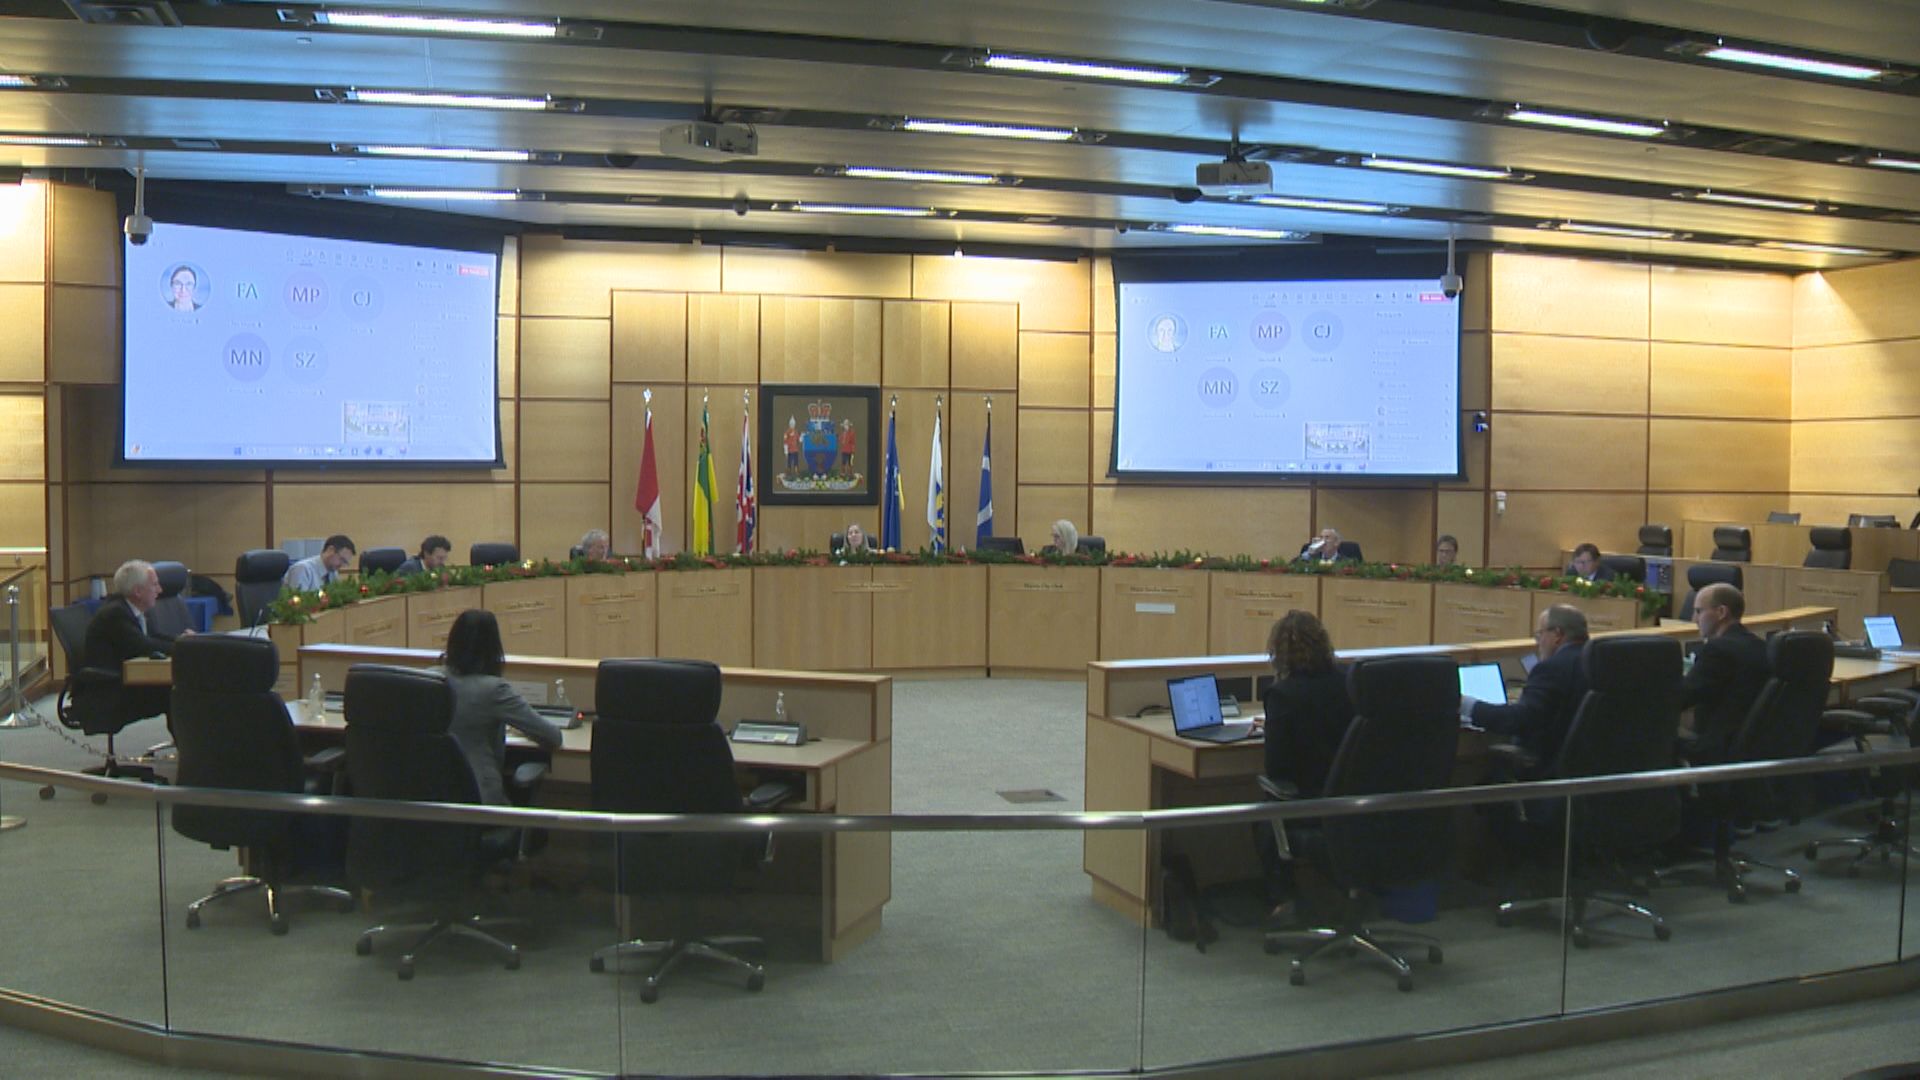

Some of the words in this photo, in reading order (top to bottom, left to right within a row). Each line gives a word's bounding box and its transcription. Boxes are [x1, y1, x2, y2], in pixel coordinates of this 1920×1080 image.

[292, 285, 321, 303] MP
[352, 290, 371, 307] CJ
[1209, 325, 1228, 339] FA
[1257, 324, 1284, 340] MP
[1313, 324, 1332, 340] CJ
[231, 349, 263, 366] MN
[295, 352, 316, 368] SZ
[1204, 380, 1232, 394] MN
[1260, 380, 1279, 394] SZ
